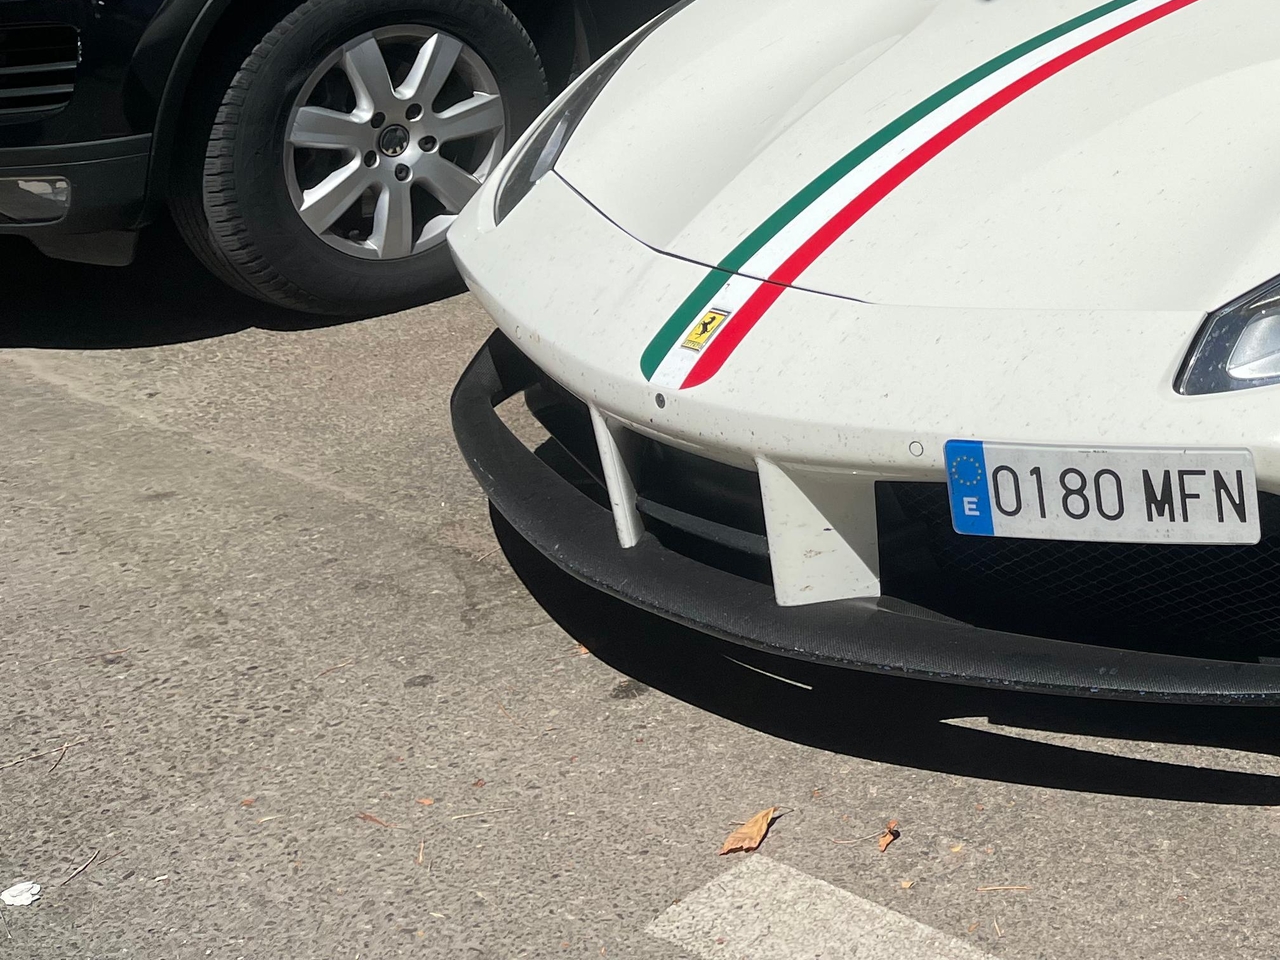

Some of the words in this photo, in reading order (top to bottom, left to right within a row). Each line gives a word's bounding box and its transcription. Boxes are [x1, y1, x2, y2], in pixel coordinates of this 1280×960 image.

[963, 496, 981, 517] E
[991, 464, 1126, 522] 0180
[1142, 468, 1248, 524] MFN
